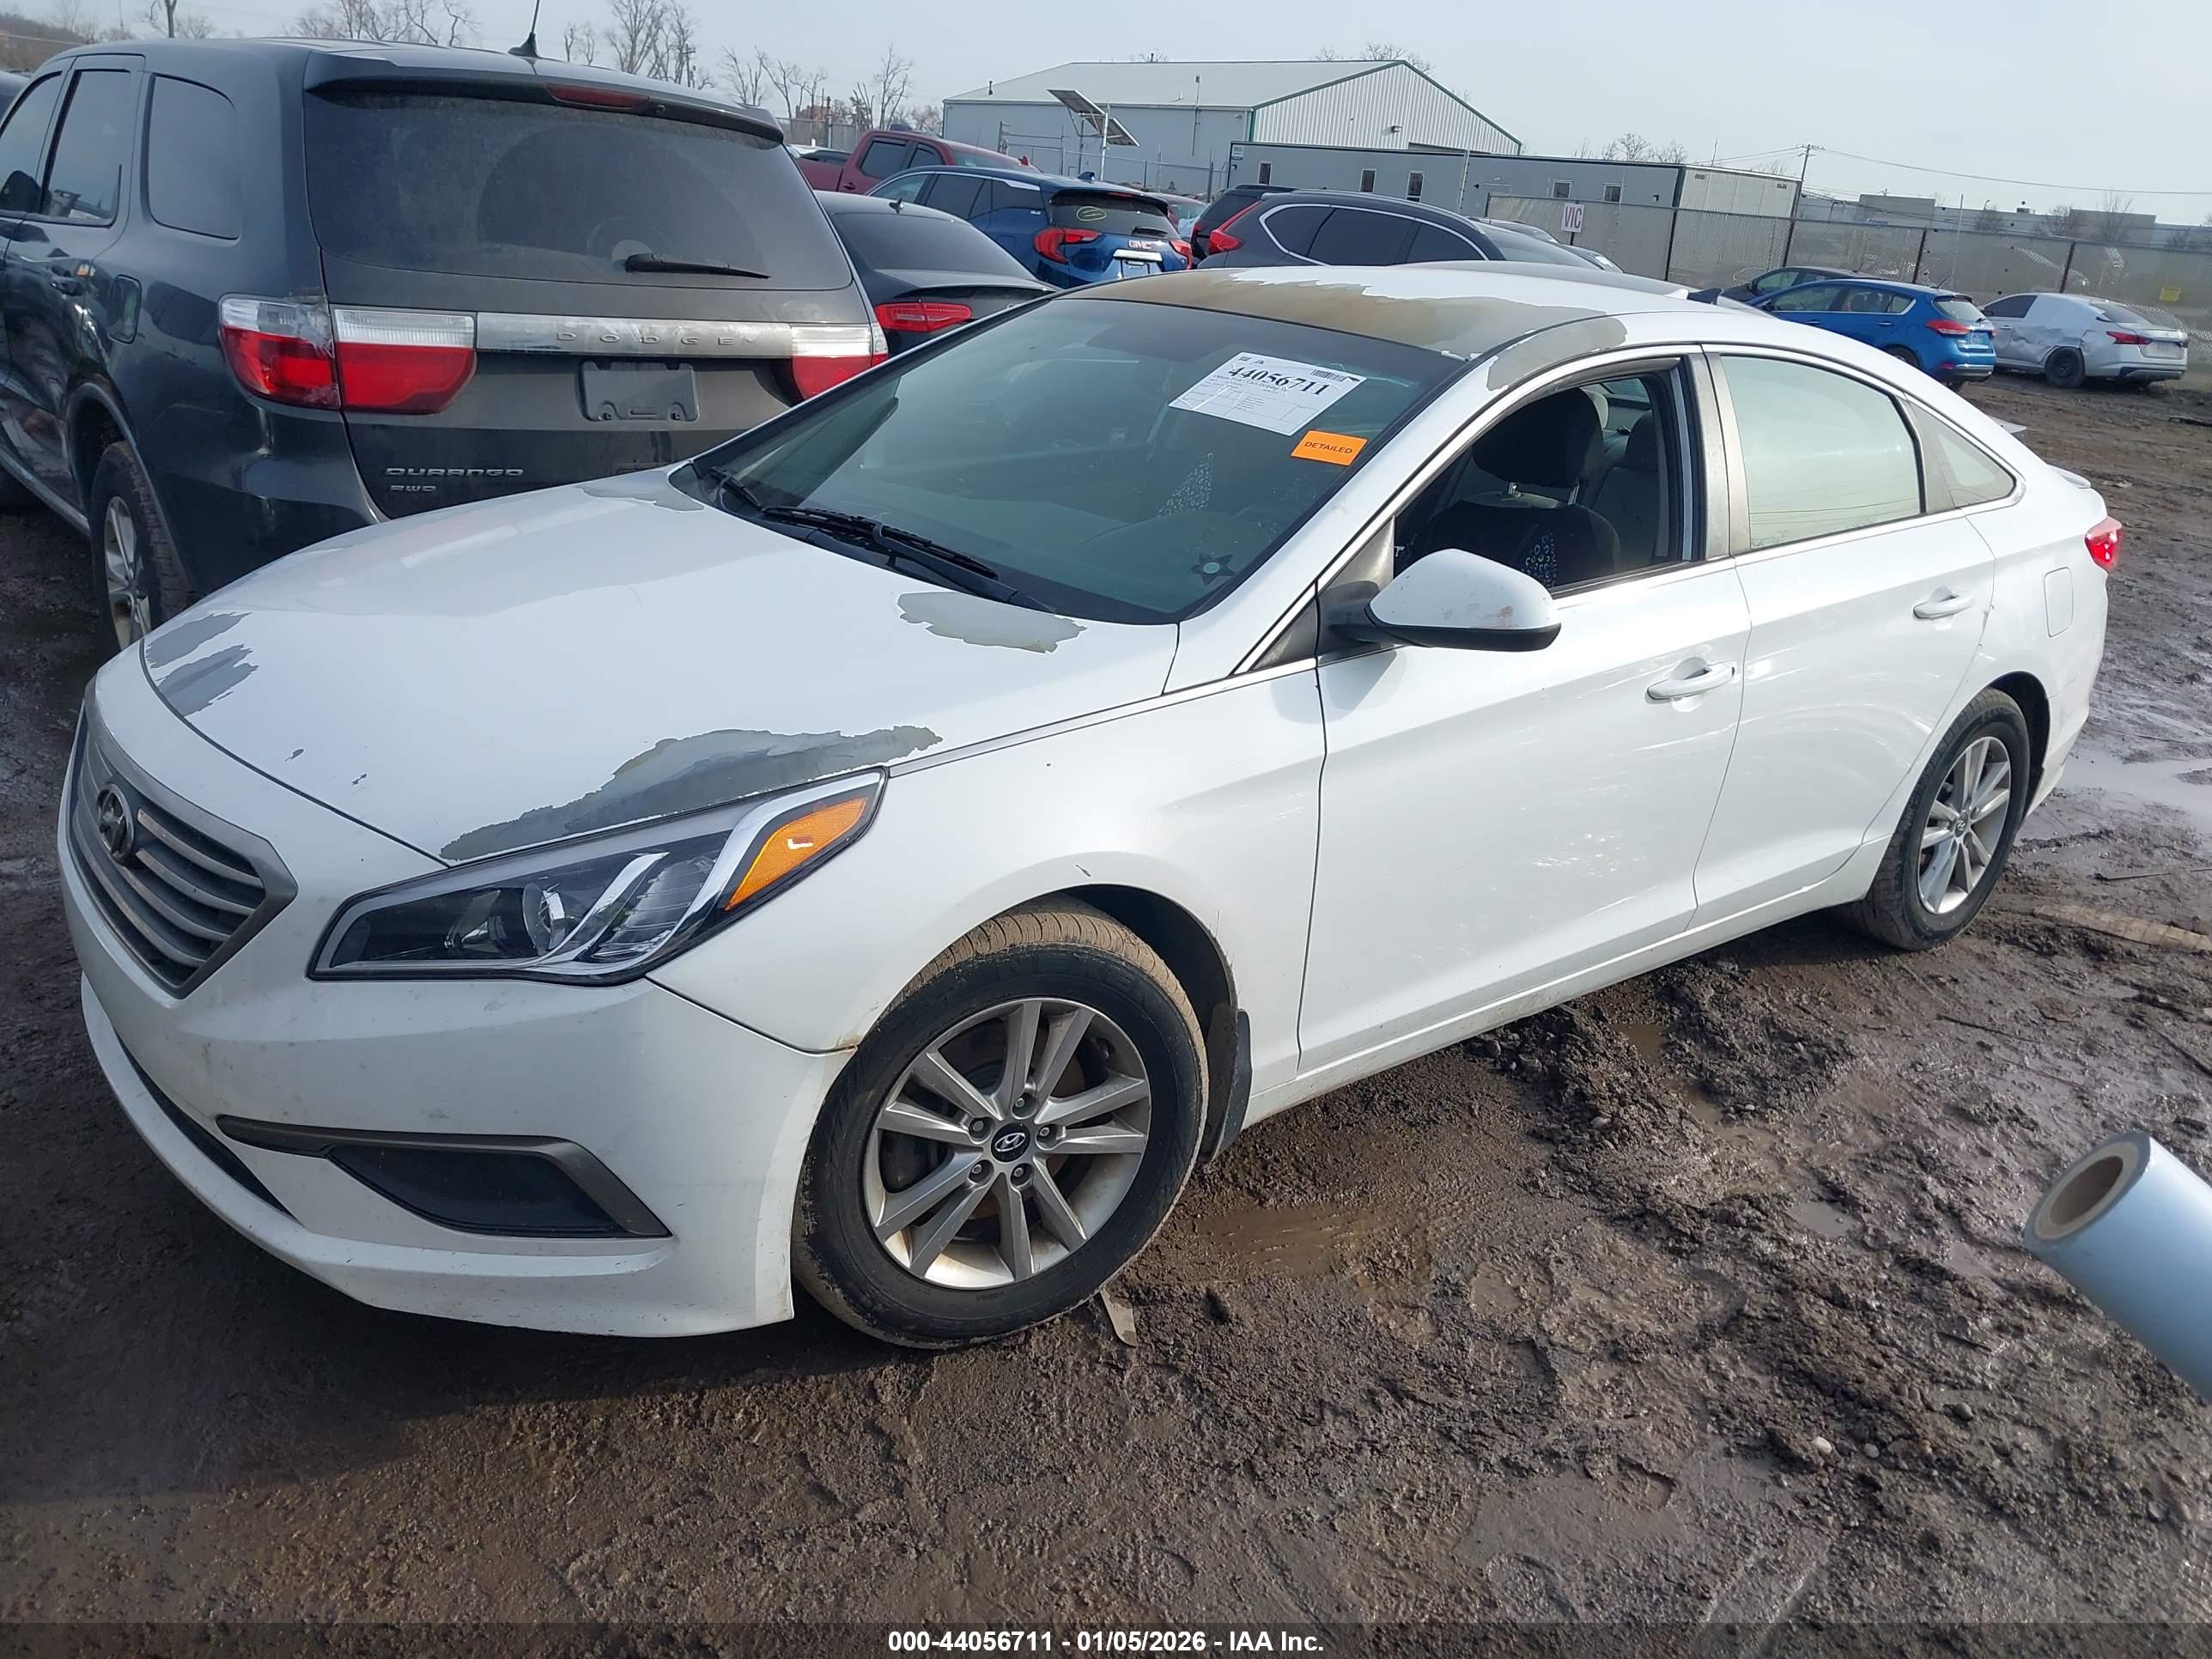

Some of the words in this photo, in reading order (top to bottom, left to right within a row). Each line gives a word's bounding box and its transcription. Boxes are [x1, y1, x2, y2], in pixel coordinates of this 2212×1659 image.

[1565, 206, 1583, 229] VIC
[1128, 240, 1152, 250] GMC
[557, 331, 734, 345] DODGE
[1228, 366, 1330, 395] 44056711
[1304, 441, 1353, 454] DETAILED
[386, 467, 524, 477] DURANGO
